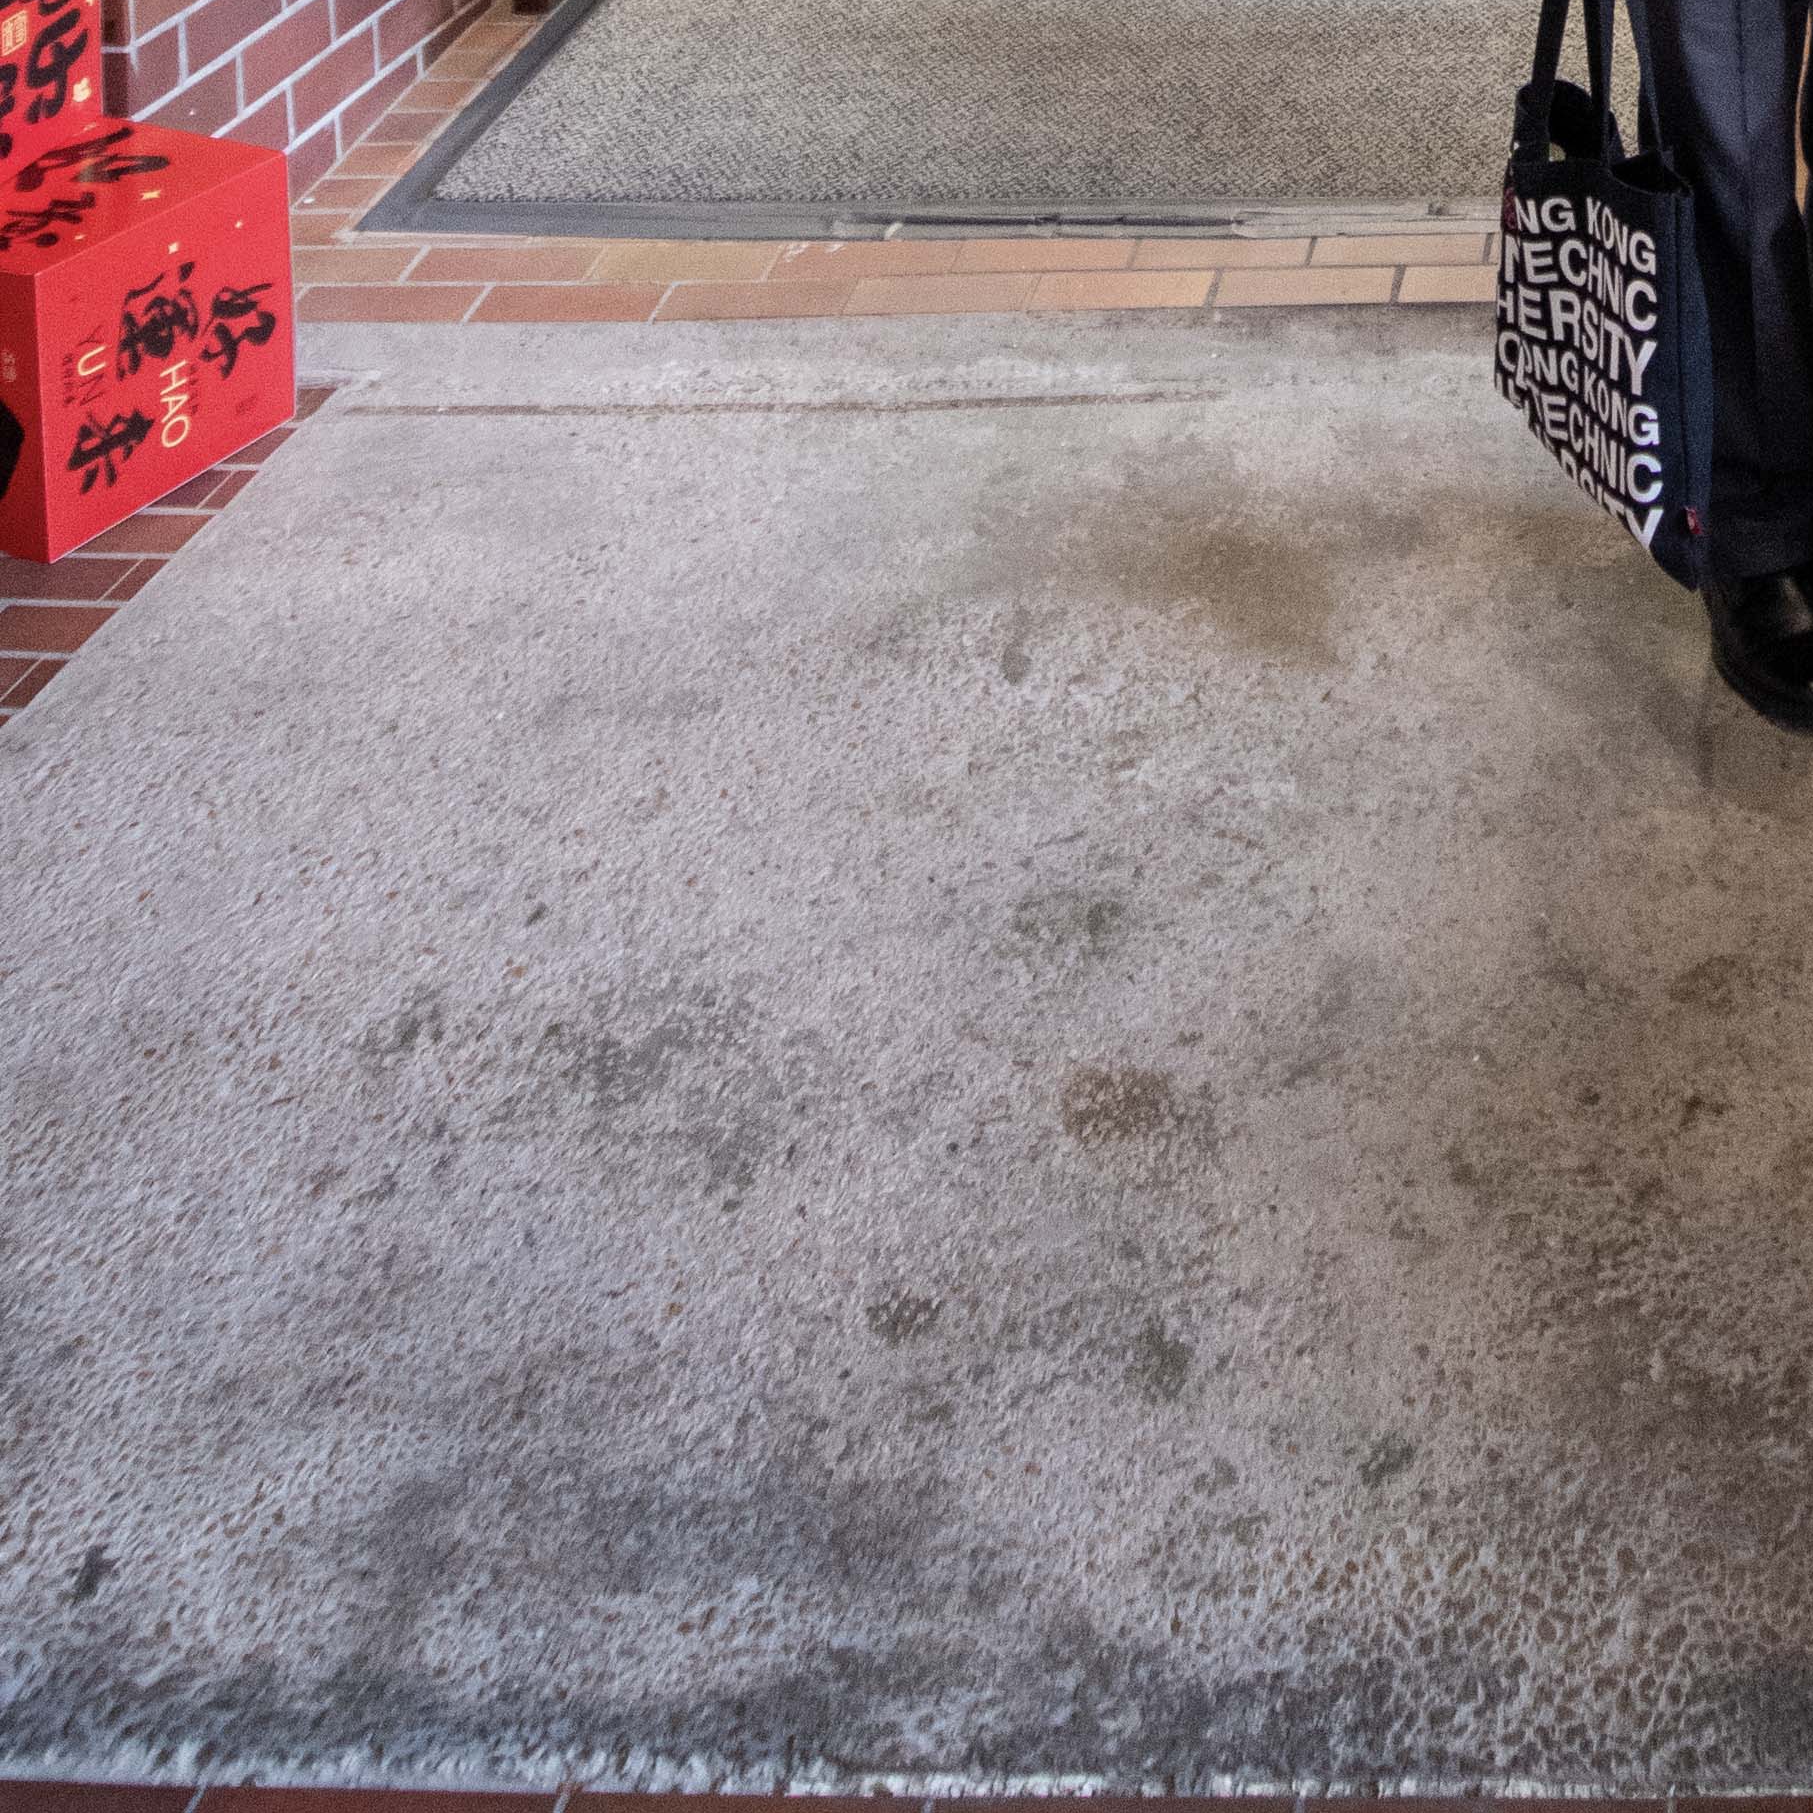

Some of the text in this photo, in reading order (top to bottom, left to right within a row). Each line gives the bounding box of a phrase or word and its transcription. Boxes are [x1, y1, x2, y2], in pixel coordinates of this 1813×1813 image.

[1586, 196, 1657, 276] KONG
[159, 359, 191, 450] HAO
[1583, 365, 1660, 447] KONG
